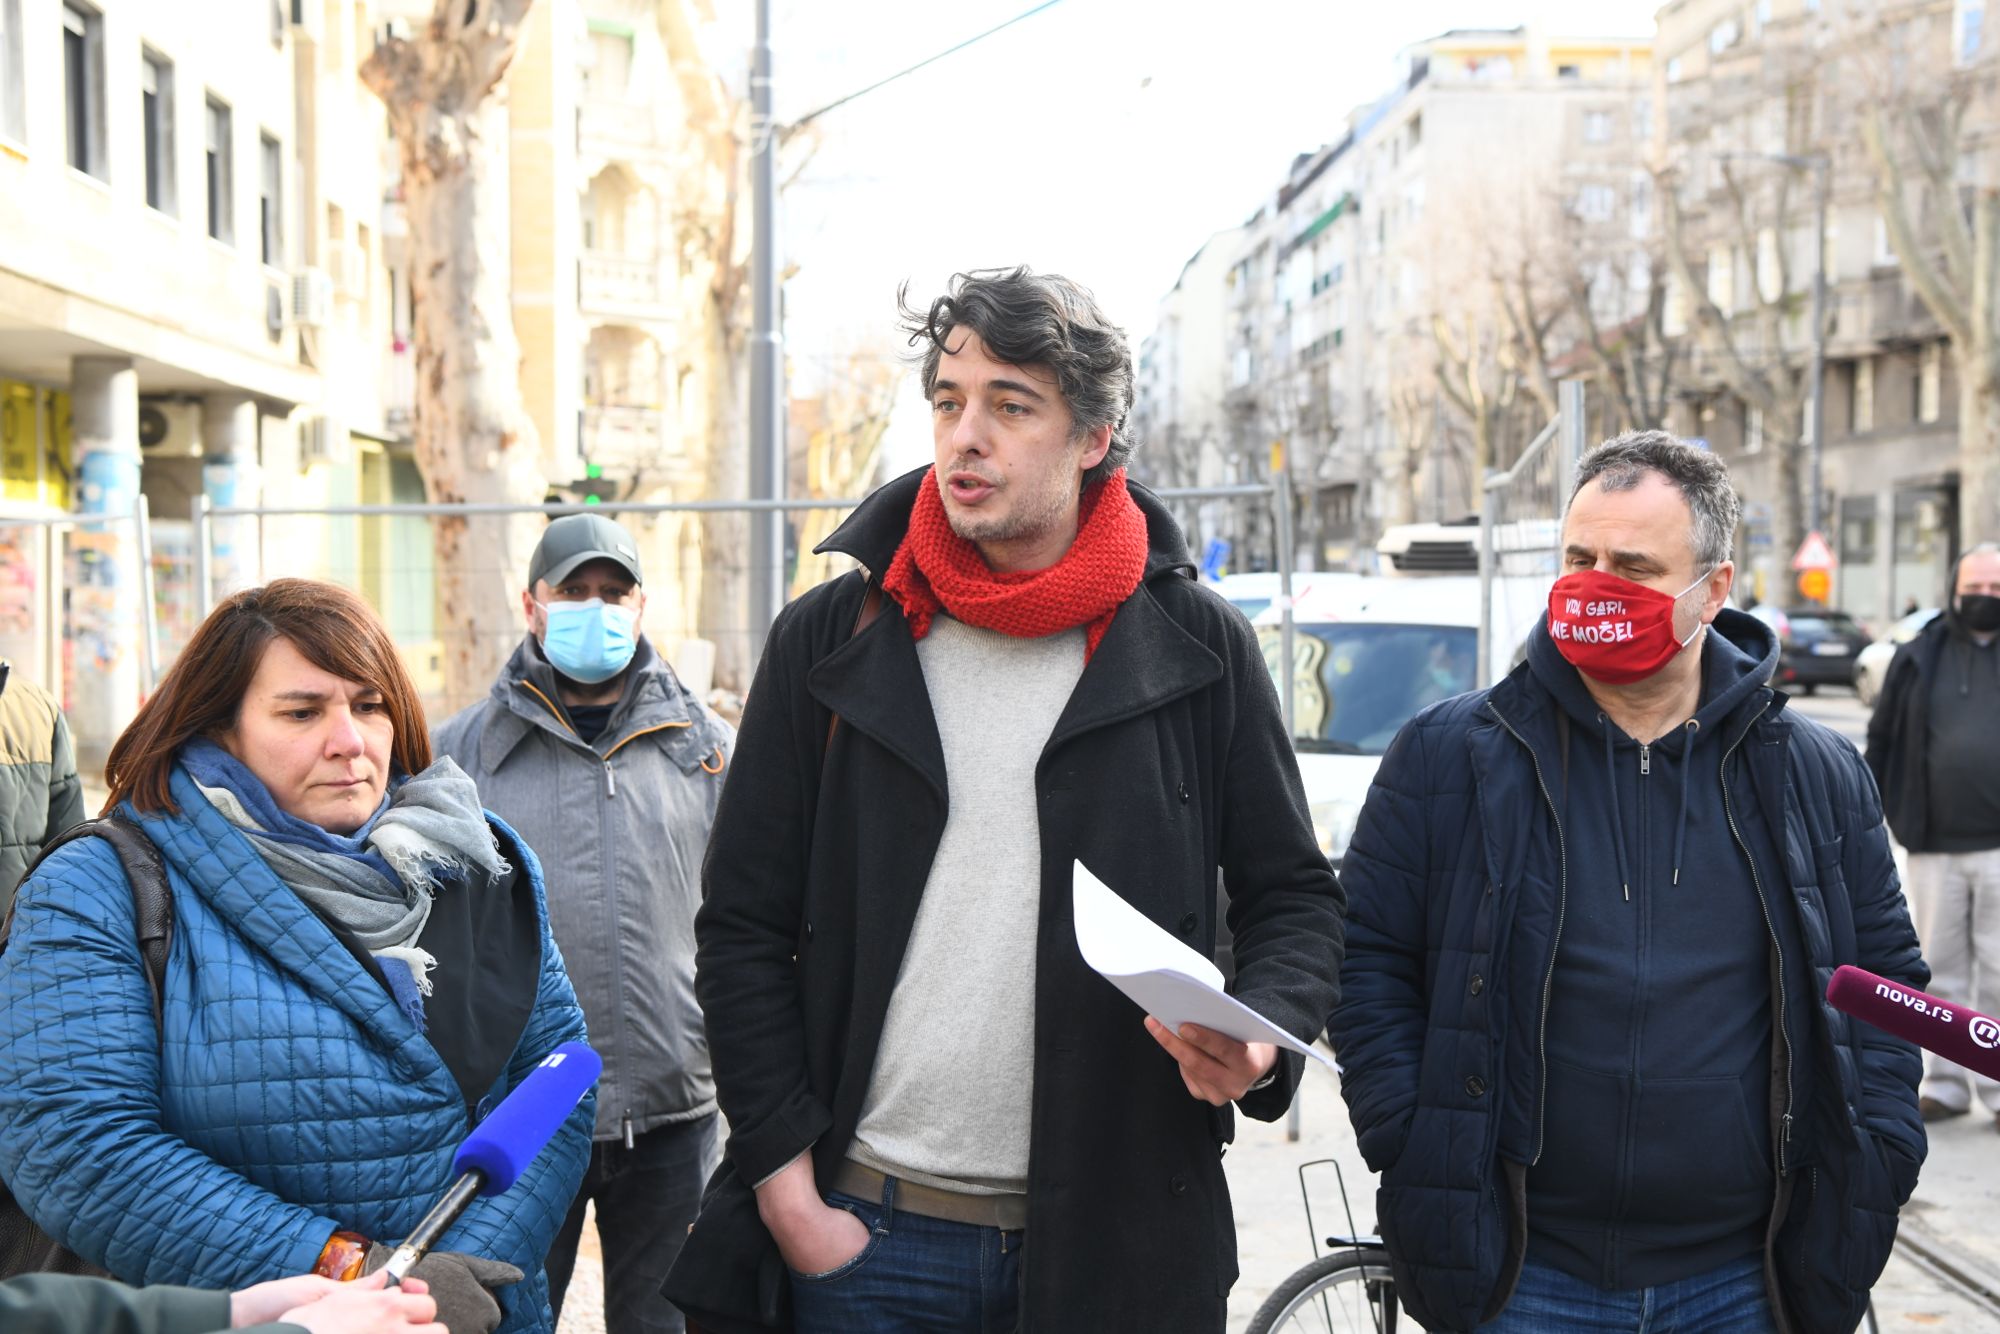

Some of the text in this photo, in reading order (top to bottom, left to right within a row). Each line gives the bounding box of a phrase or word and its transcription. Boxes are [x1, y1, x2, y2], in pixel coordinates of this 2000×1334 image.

[1551, 620, 1634, 643] NE MOŽE!
[1875, 983, 1953, 1023] nova.rs
